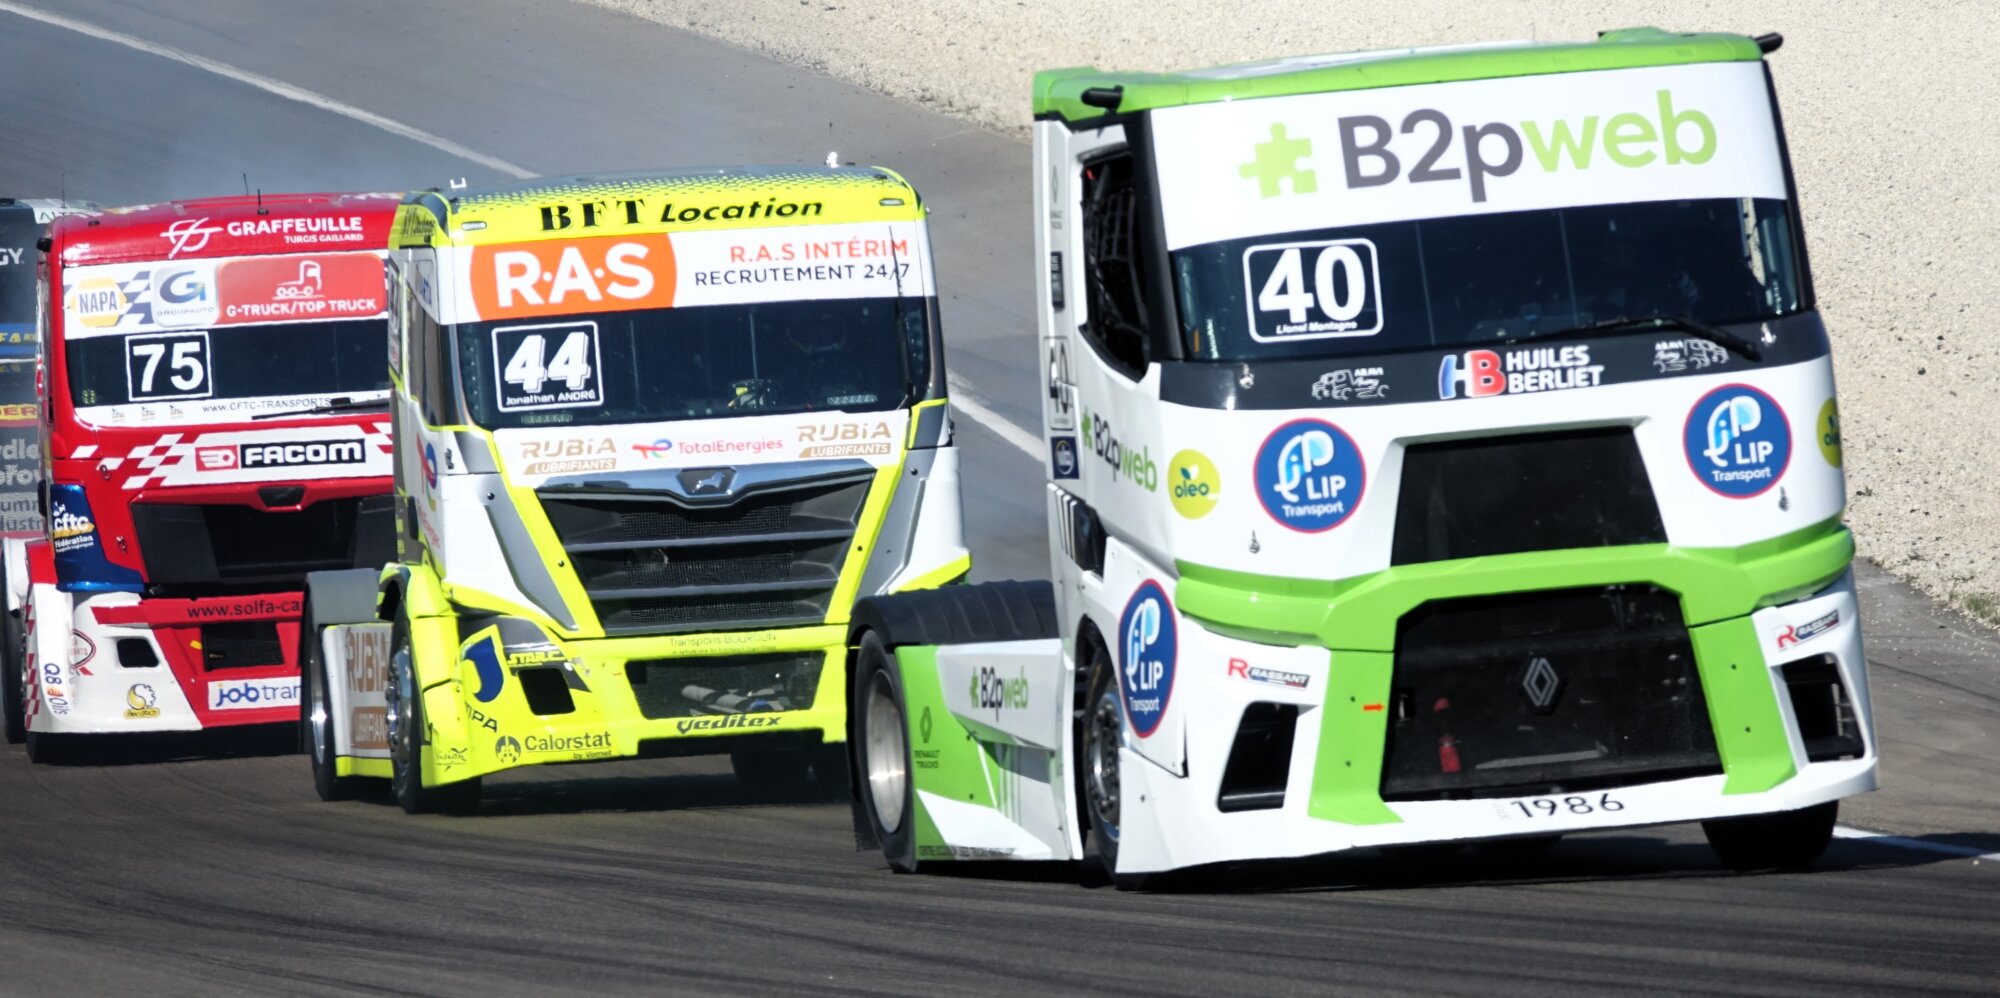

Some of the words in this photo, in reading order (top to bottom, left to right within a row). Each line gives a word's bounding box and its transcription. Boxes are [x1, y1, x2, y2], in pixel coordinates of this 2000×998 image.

[1337, 89, 1717, 203] B2pweb
[227, 216, 363, 237] GRAFFEUILLE
[541, 197, 647, 232] BFT
[659, 198, 823, 224] Location
[319, 233, 364, 243] GAILLARD
[730, 243, 795, 264] R.A.S
[805, 236, 908, 260] INTÉRIM
[695, 264, 856, 286] RECRUTEMENT
[1258, 245, 1366, 324] 40
[79, 290, 119, 314] NAPA
[329, 298, 377, 312] TRUCK
[132, 341, 204, 392] 75
[504, 330, 592, 394] 44
[1506, 345, 1591, 372] HUILES
[1507, 365, 1605, 394] BERLIET
[505, 394, 555, 406] Jonathan
[558, 389, 596, 402] ANDRÉ
[245, 442, 363, 466] FACOM
[677, 438, 783, 455] TotalEnergies
[810, 443, 889, 458] LUBRIFIANTS
[1094, 412, 1158, 493] B2pweb
[1734, 440, 1773, 466] LIP
[534, 459, 613, 474] LUBRIFIANTS
[1711, 465, 1772, 484] Transport
[1174, 478, 1210, 499] oleo
[1305, 473, 1347, 501] LIP
[1281, 499, 1344, 518] Transport
[54, 512, 89, 531] cftc
[44, 662, 62, 685] Q8
[1139, 660, 1164, 692] LIP
[980, 666, 1029, 720] B2pweb
[1128, 696, 1160, 714] Transport
[524, 731, 612, 751] Calorstat
[1510, 792, 1625, 818] 1986
